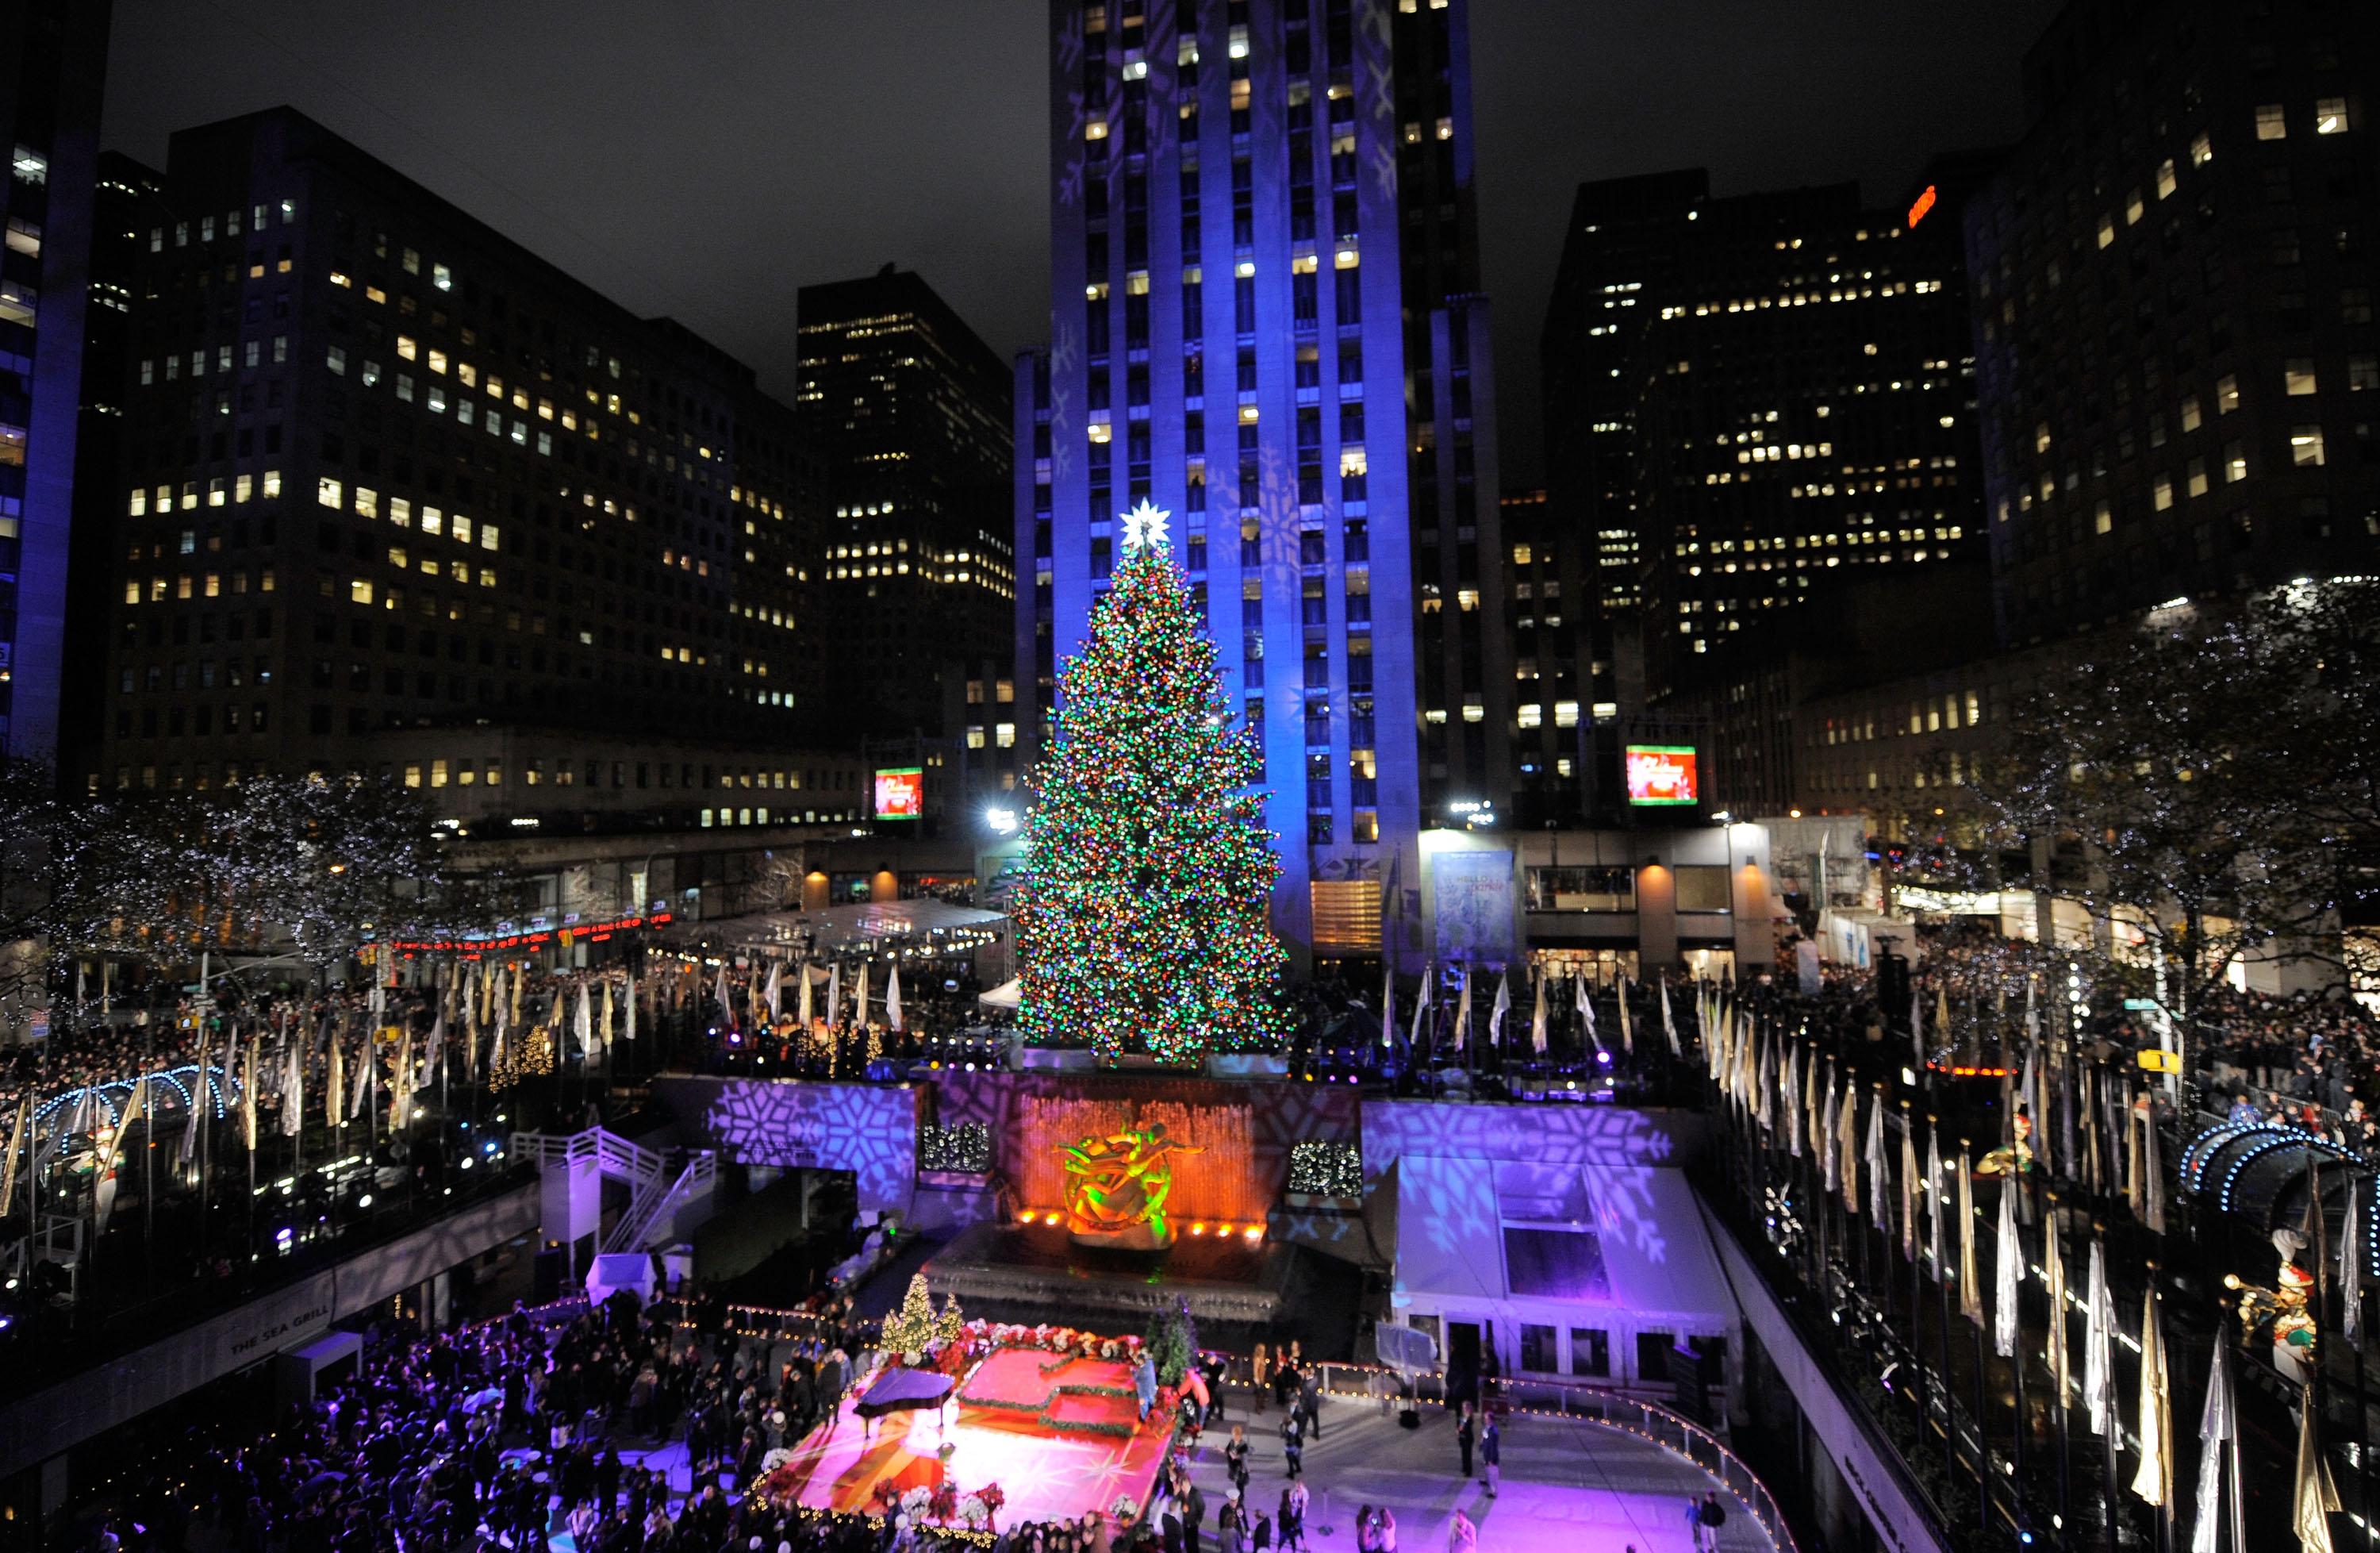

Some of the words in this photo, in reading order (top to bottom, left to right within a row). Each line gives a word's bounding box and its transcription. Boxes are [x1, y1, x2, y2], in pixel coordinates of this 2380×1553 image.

[21, 293, 35, 305] 10
[231, 1336, 257, 1355] THE
[263, 1323, 289, 1342] SEA
[293, 1305, 330, 1328] GRILL
